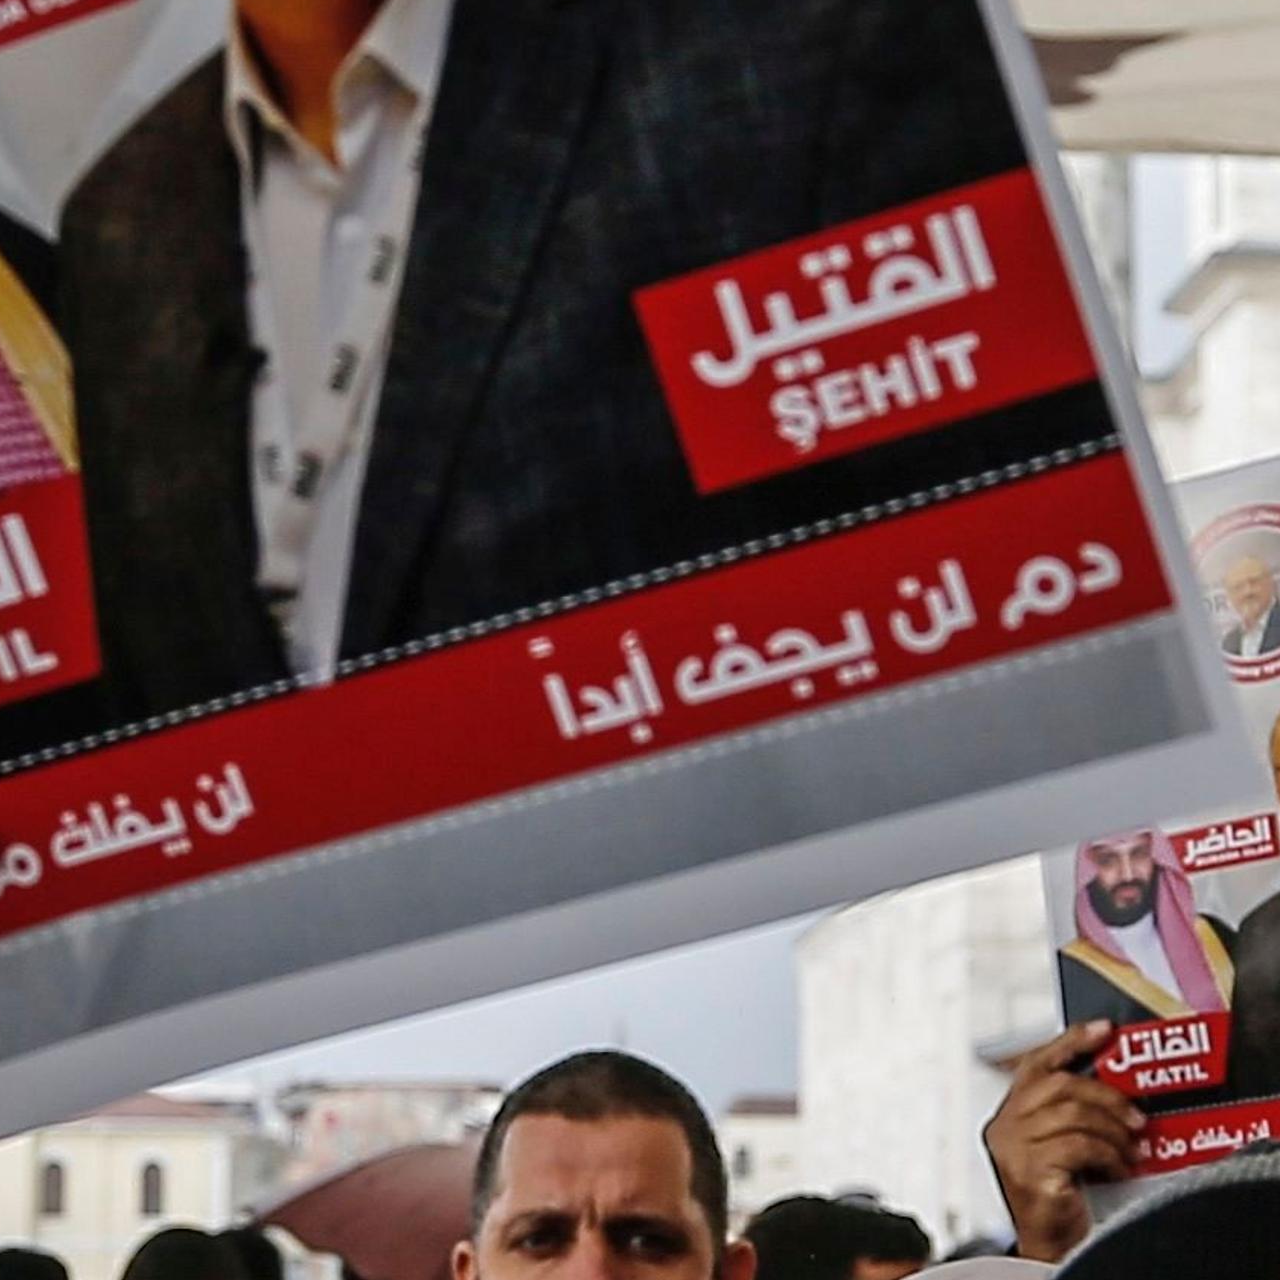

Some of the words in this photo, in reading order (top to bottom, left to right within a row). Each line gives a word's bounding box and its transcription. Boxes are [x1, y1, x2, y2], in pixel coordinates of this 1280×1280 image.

[690, 203, 997, 388] القتيل
[769, 330, 982, 455] ŞEHİT
[890, 558, 978, 654] لن
[999, 540, 1122, 630] دم
[674, 608, 878, 699] يجف
[51, 794, 192, 867] يفلت
[192, 762, 256, 836] لن
[1183, 816, 1271, 865] الحاضر
[1106, 1022, 1210, 1072] القاتل
[1135, 1063, 1209, 1090] KATIL
[1156, 1137, 1187, 1159] من
